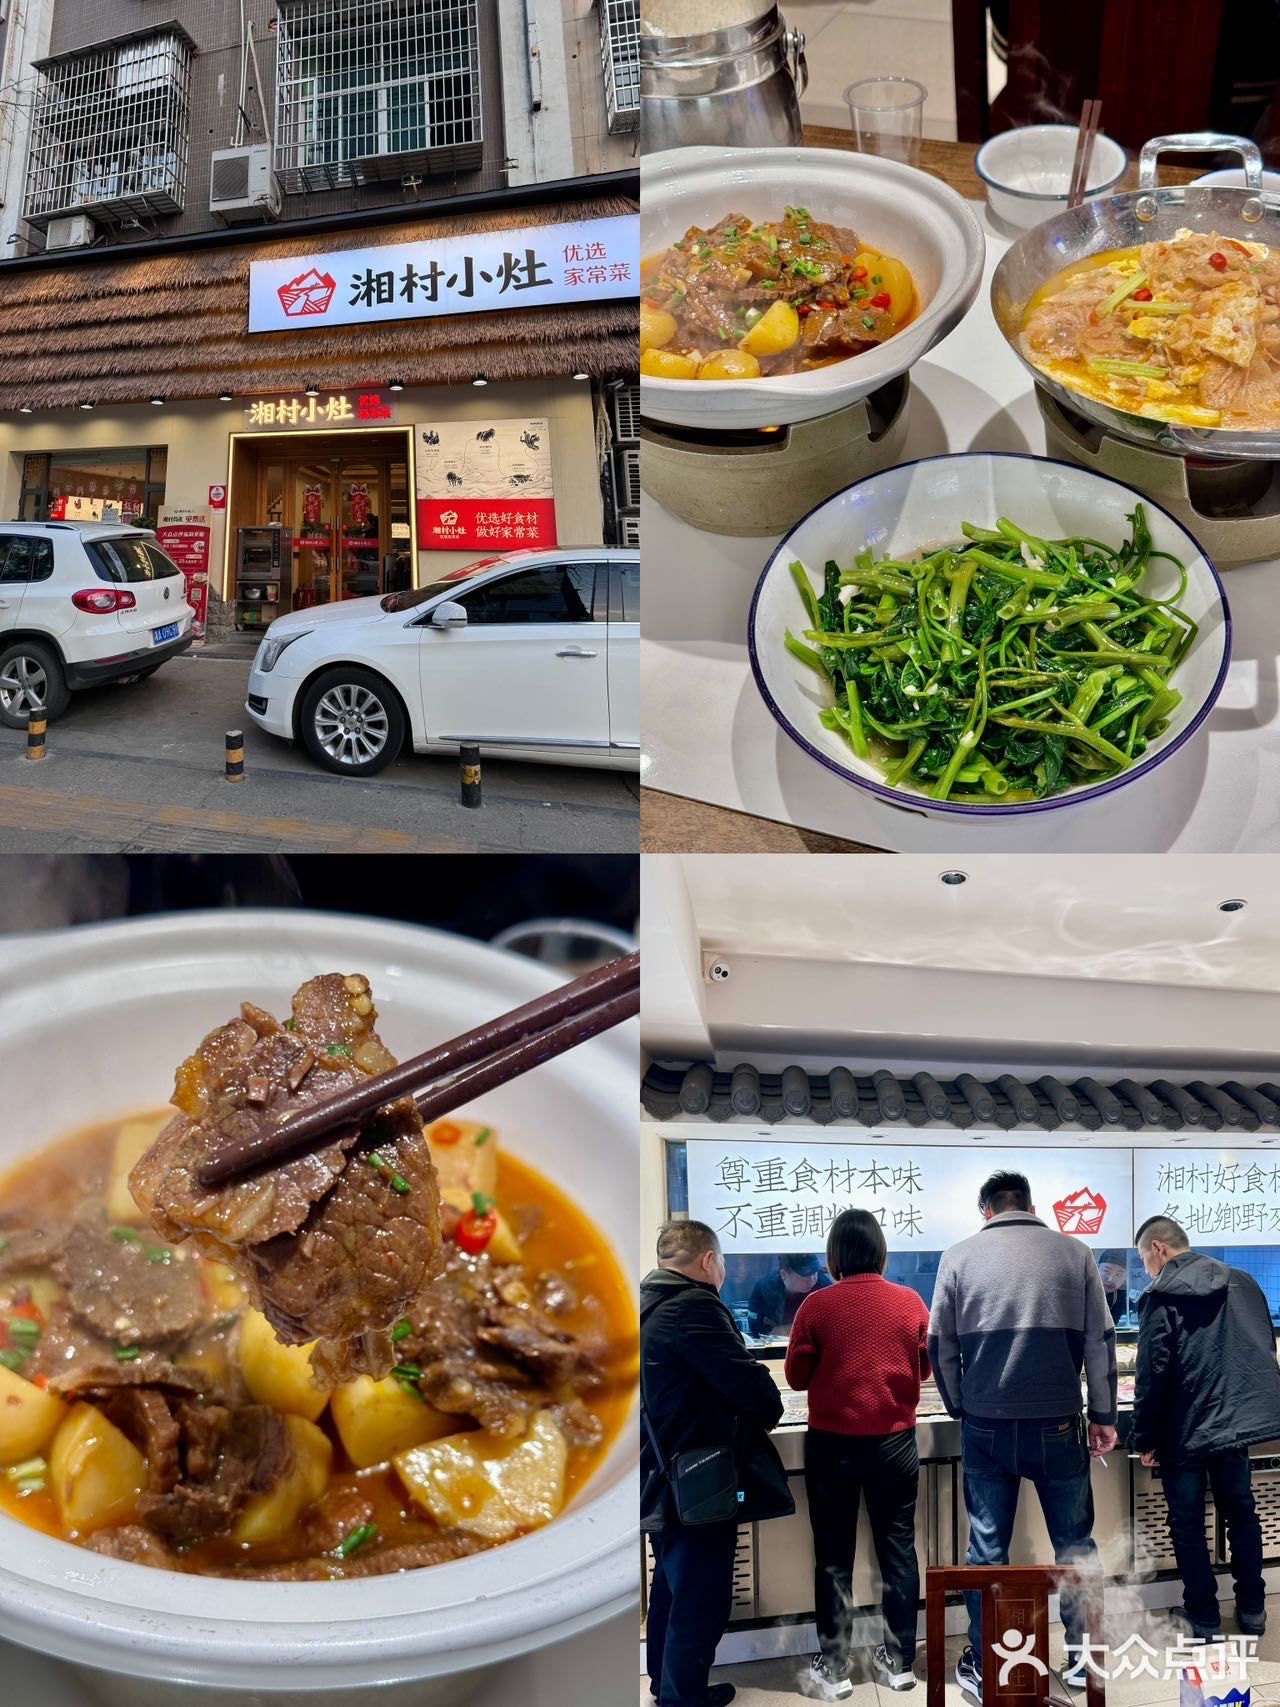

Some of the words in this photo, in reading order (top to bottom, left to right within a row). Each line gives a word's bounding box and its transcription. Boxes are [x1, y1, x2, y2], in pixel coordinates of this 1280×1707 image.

[562, 241, 608, 263] 优选
[348, 248, 553, 308] 湘村小灶
[563, 262, 632, 287] 家常菜
[249, 396, 355, 425] 湘村小灶
[475, 511, 539, 525] 优选好食材
[432, 526, 467, 535] 湘村小灶
[475, 525, 540, 539] 做好家常菜
[714, 1155, 924, 1195] 尊重食材本味
